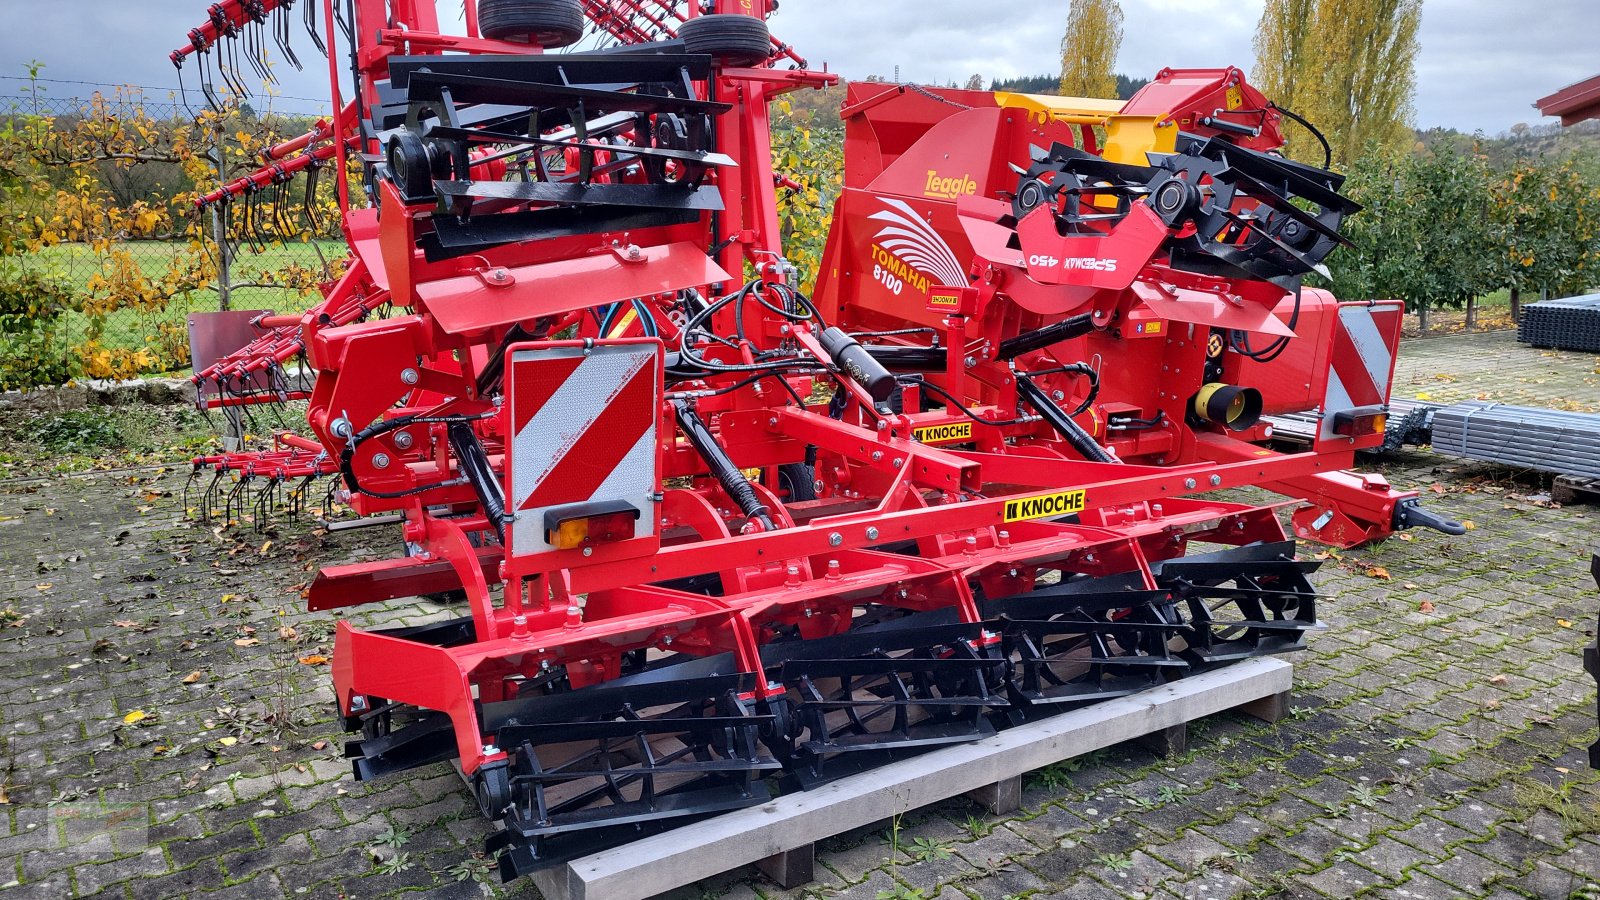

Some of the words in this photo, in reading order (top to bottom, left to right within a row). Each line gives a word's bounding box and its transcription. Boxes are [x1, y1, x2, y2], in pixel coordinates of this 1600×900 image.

[924, 170, 976, 198] Teagle
[871, 243, 934, 294] TOMAHA
[1029, 254, 1059, 267] 450
[1064, 257, 1118, 271] SPEEDMAX
[873, 264, 903, 295] 8100
[926, 425, 970, 440] KNOCHE
[1021, 493, 1083, 517] KNOCHE
